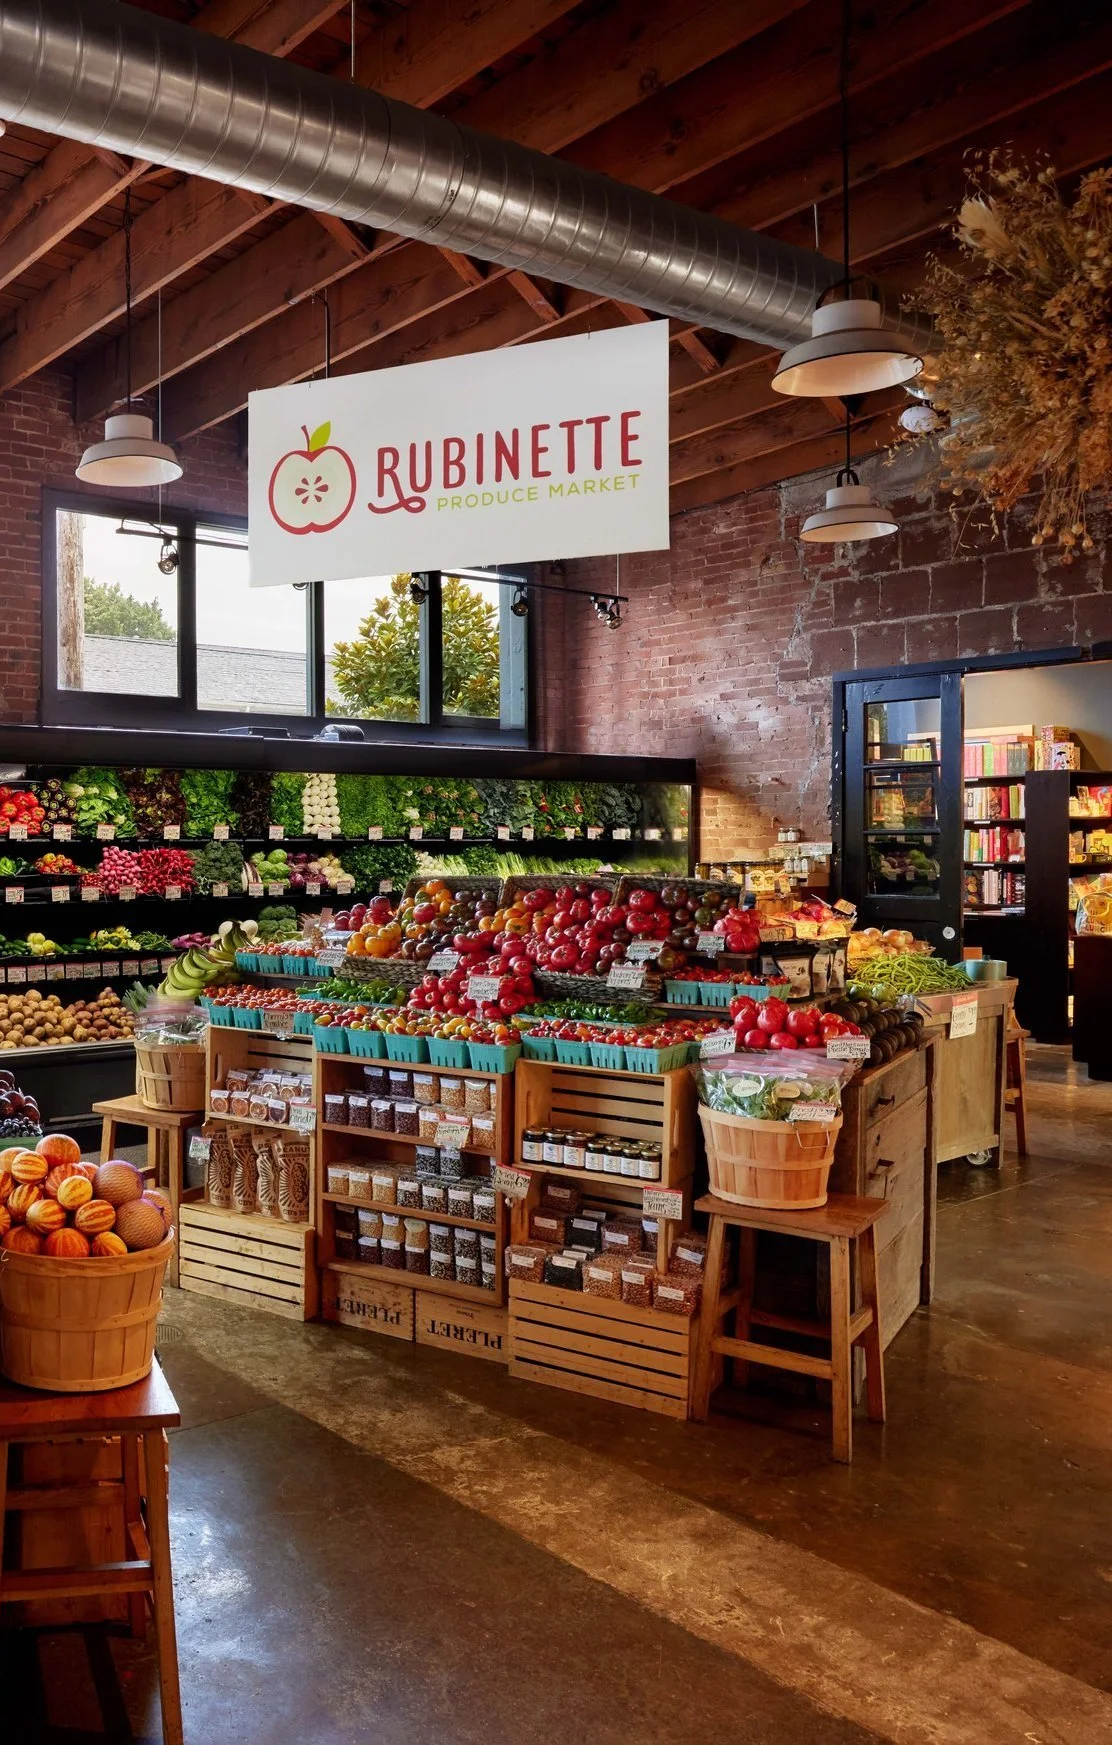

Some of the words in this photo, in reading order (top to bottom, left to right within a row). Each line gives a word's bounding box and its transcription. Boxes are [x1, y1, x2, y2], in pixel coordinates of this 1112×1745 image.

[367, 410, 643, 515] RUBINETTE
[436, 487, 539, 512] PRODUCE
[548, 473, 641, 498] MARKET
[426, 1319, 504, 1350] PLERET
